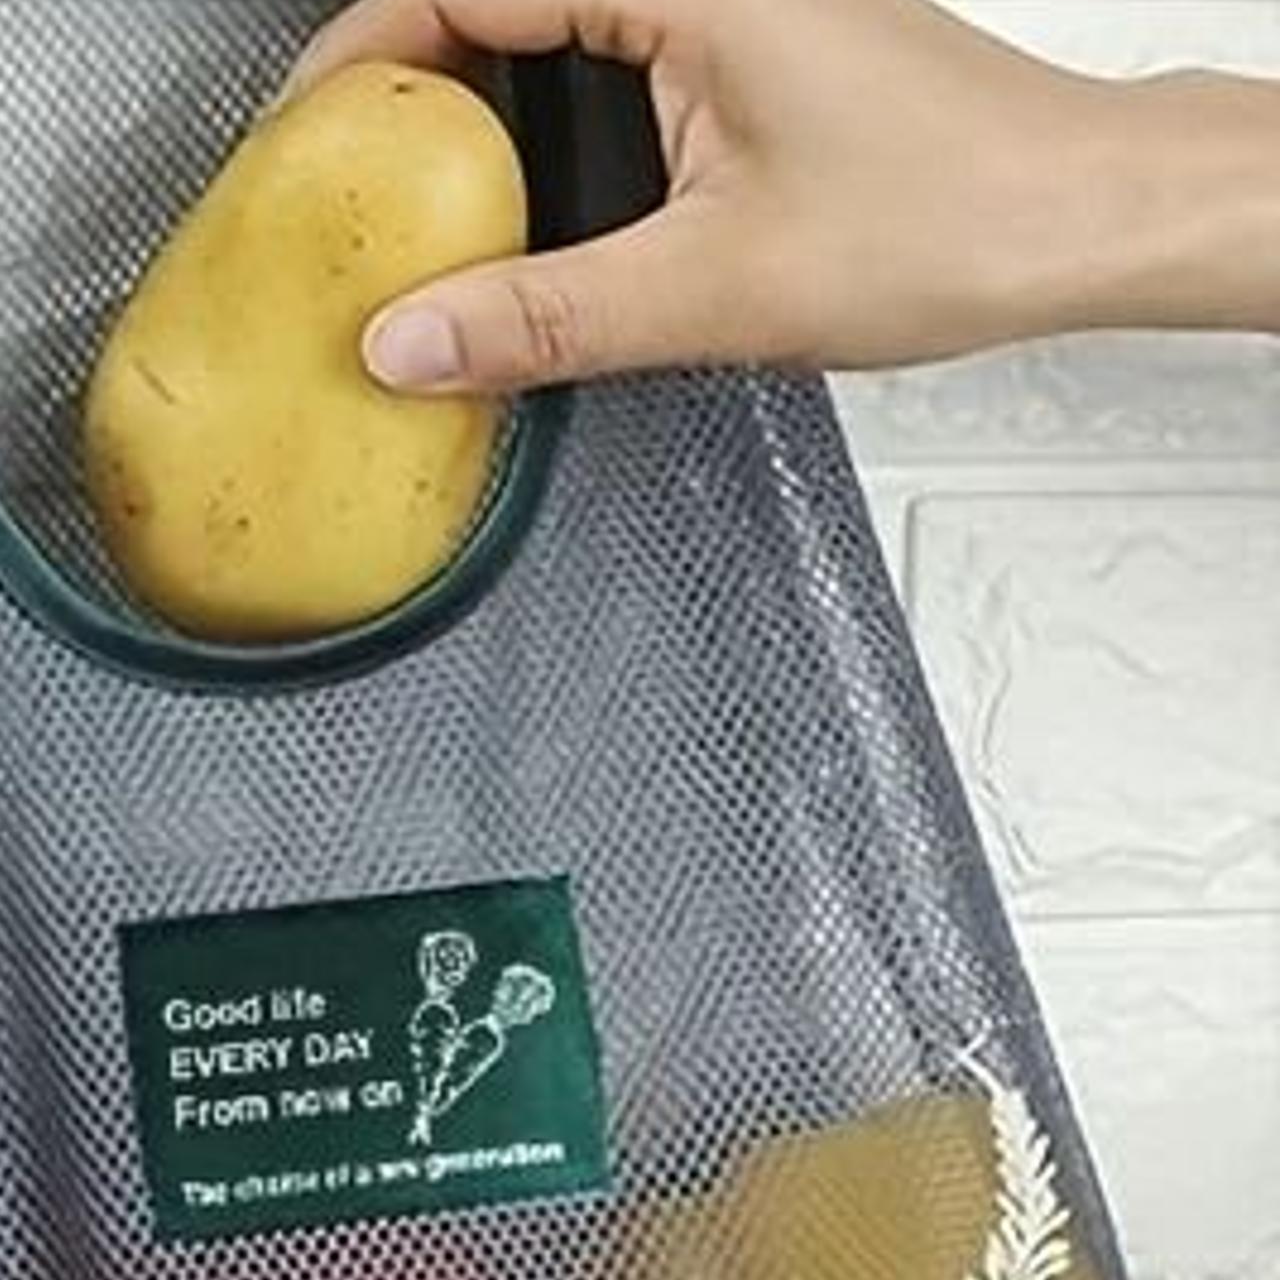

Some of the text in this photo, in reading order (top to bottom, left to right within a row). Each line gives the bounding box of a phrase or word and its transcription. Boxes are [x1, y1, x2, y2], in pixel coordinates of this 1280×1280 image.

[163, 986, 326, 1031] Good life
[170, 1028, 374, 1079] EVERY DAY
[174, 1080, 404, 1131] From now on
